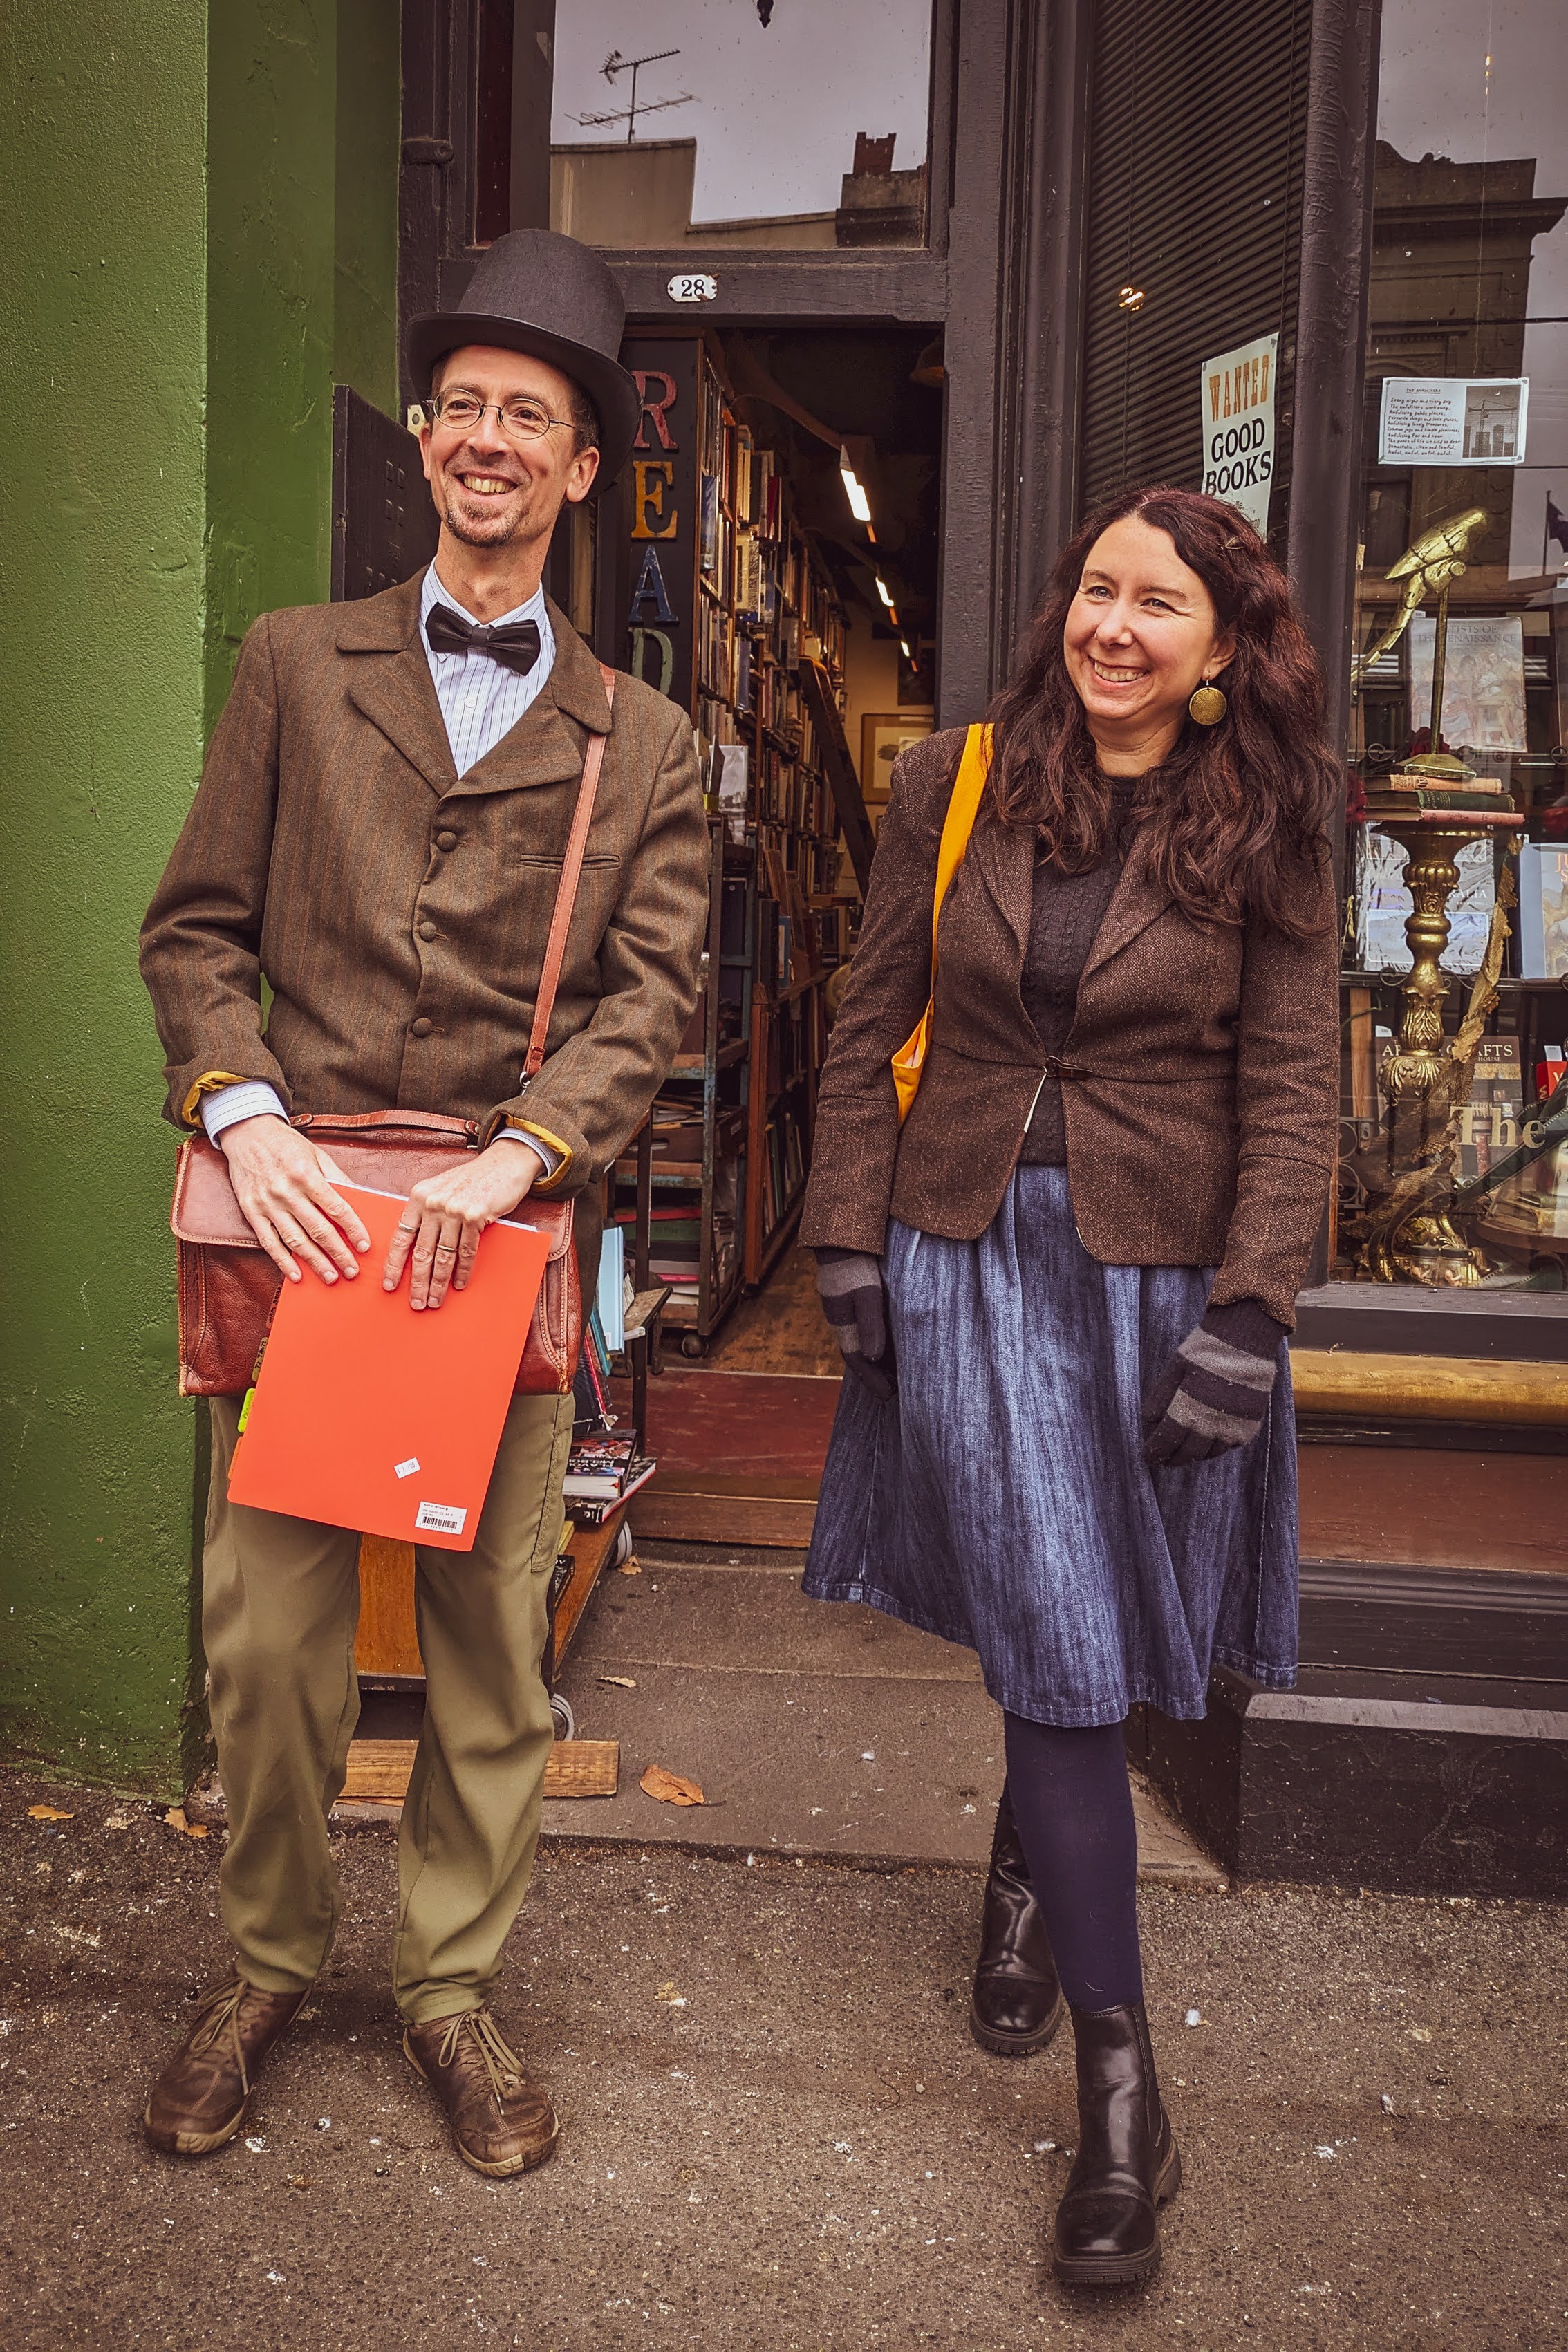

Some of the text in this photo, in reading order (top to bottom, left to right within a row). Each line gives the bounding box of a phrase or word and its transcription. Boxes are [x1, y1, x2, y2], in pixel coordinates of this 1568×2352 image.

[681, 279, 704, 297] 28
[1209, 355, 1269, 422] WANTED
[1211, 418, 1265, 463] GOOD
[1206, 451, 1271, 497] BOOKS
[628, 370, 680, 697] READ
[1448, 634, 1518, 642] ENAISSANCE
[1450, 1106, 1546, 1148] The
